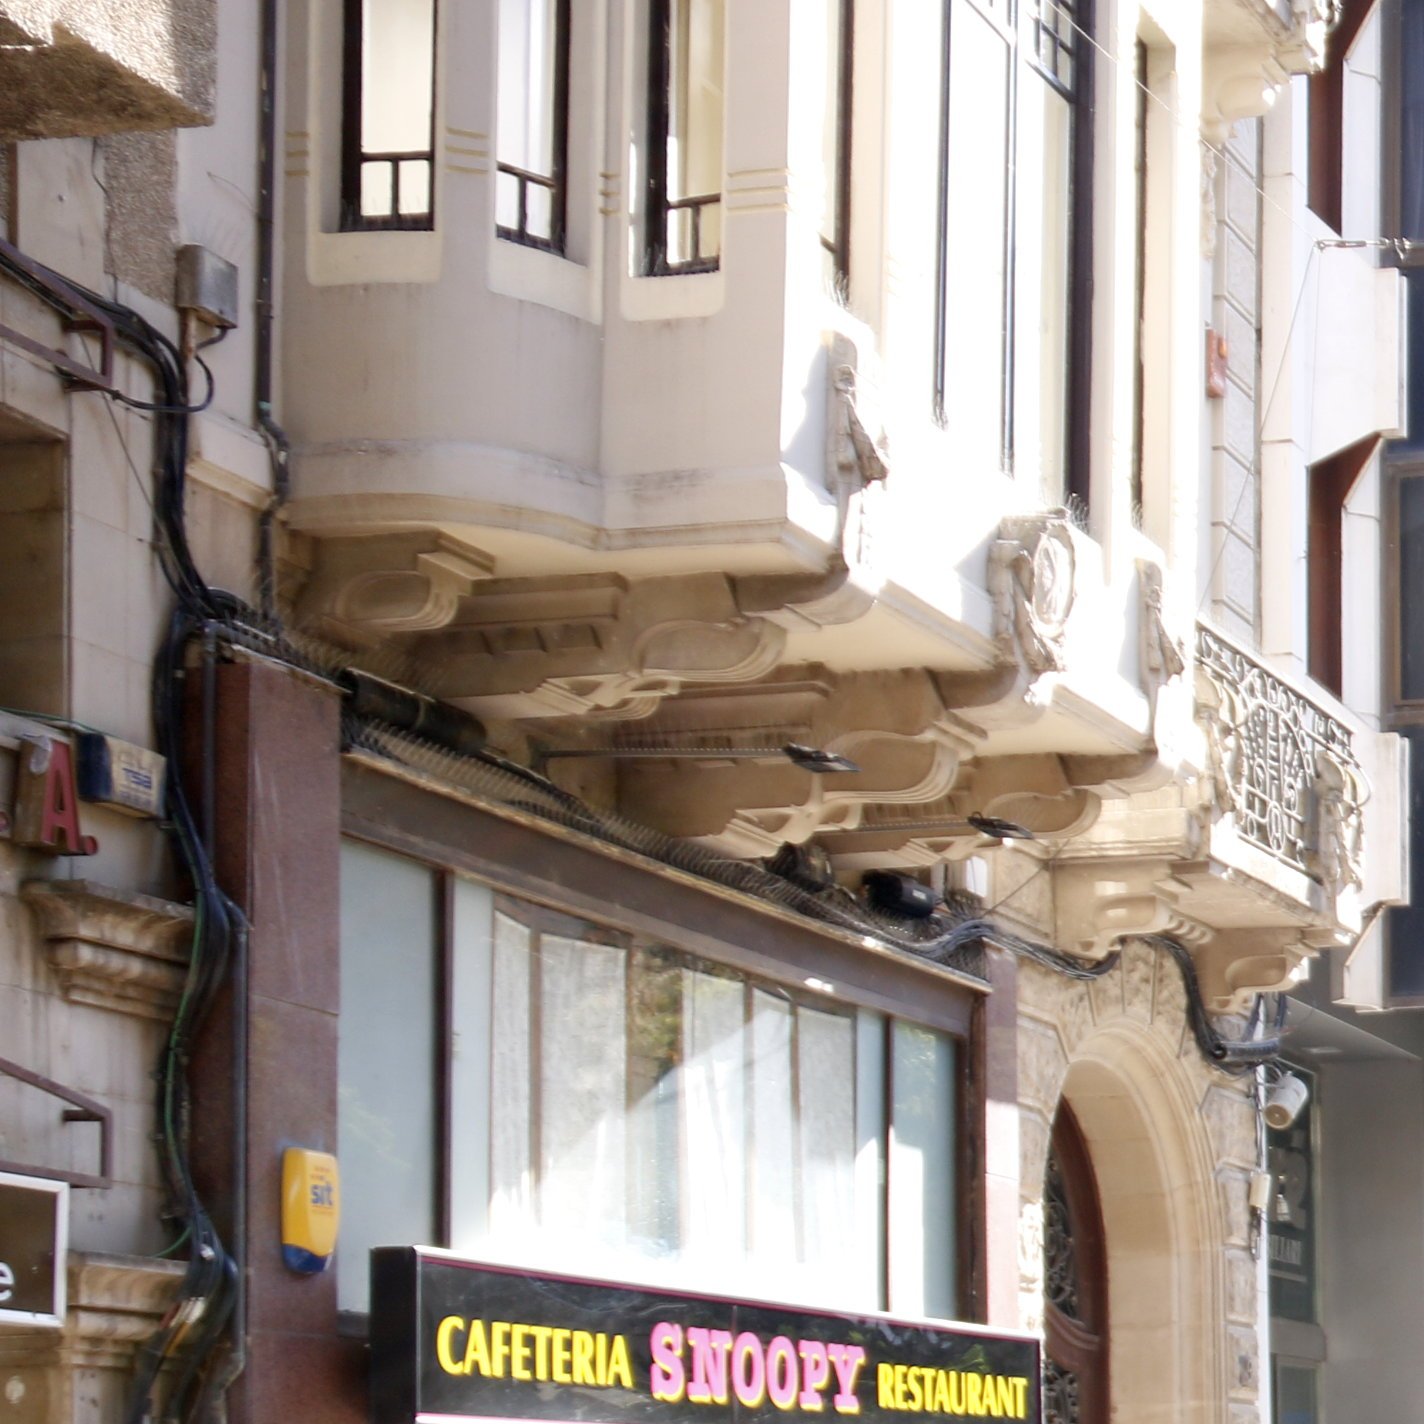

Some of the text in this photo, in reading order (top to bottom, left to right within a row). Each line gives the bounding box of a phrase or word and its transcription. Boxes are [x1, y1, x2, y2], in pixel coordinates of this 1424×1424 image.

[436, 1315, 1028, 1419] CAFETERIA SNOOPY RESTAURANT
